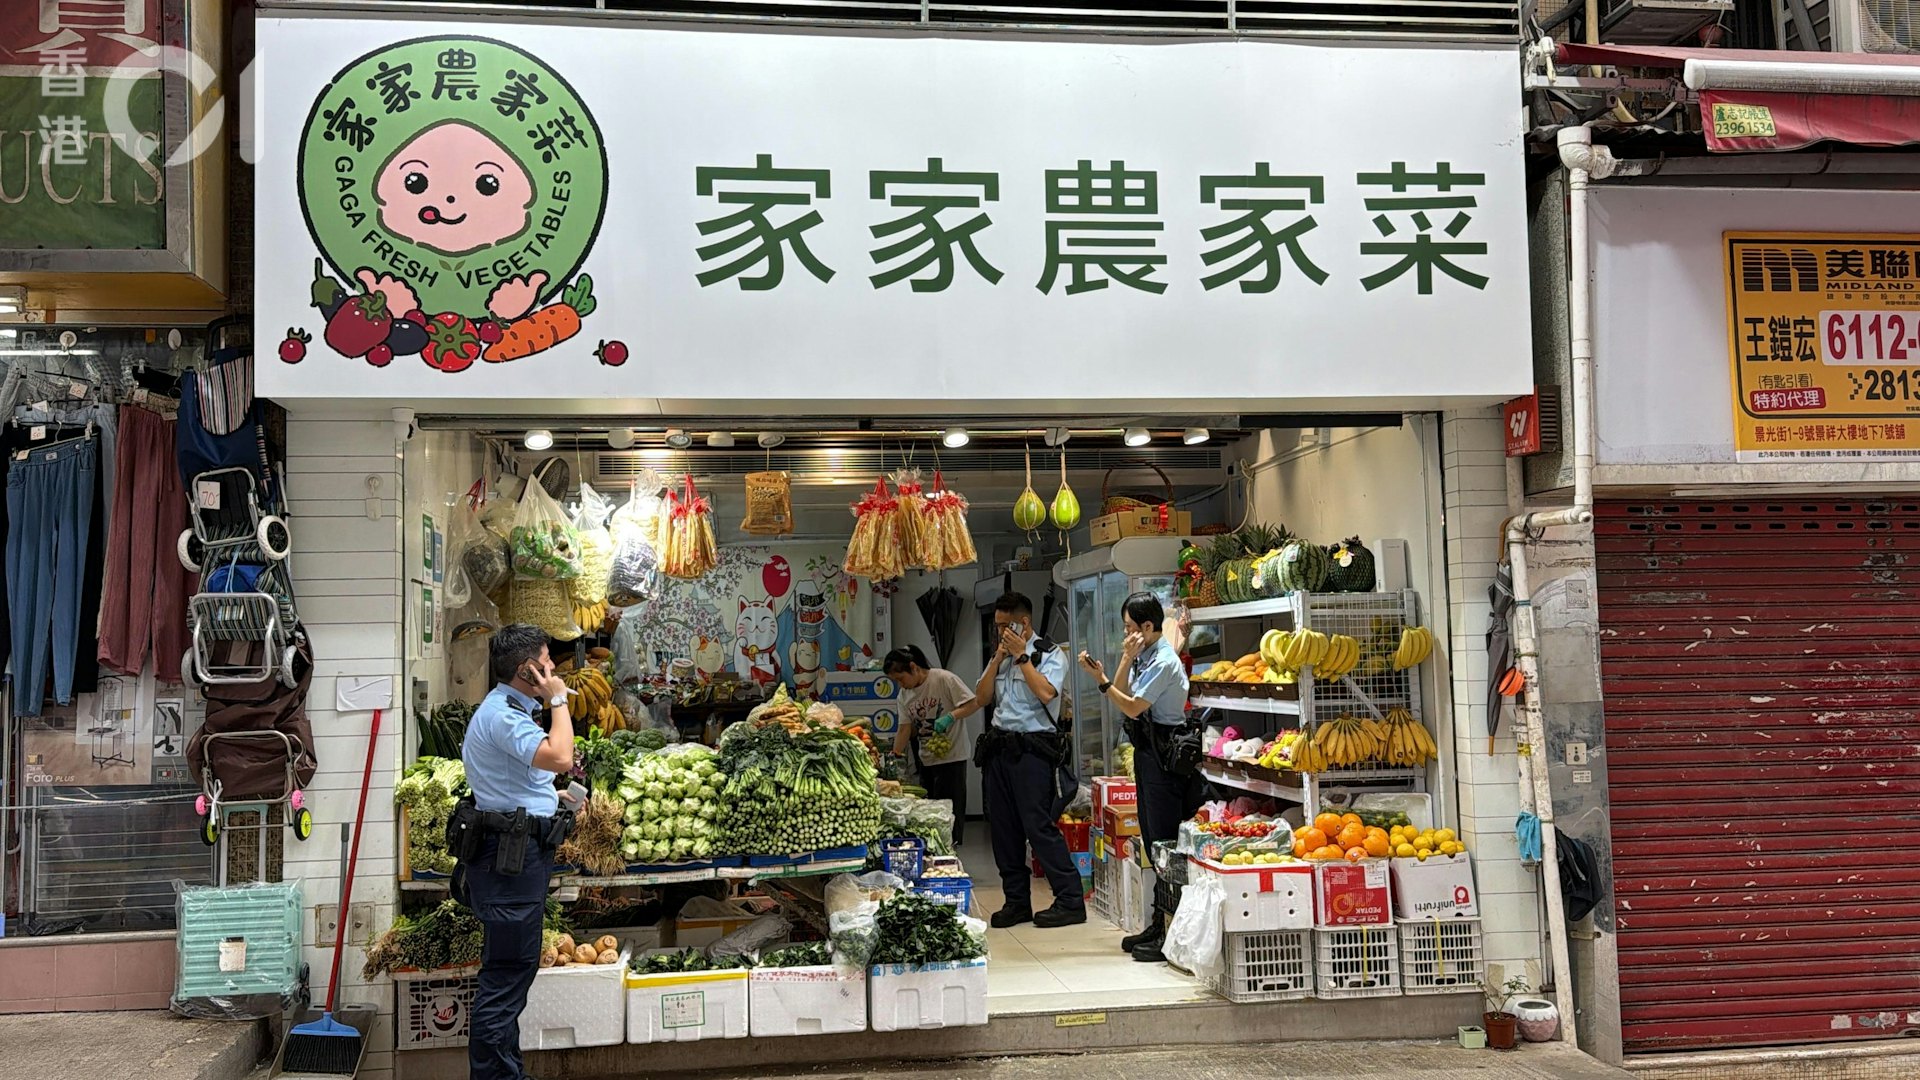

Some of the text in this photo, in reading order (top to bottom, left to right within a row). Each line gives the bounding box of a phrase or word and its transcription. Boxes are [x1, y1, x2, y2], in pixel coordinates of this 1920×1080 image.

[323, 48, 589, 164] 家家農家菜
[1716, 122, 1774, 135] 2396 1534
[335, 156, 572, 289] GAGA FRESH VEGETABLES
[695, 154, 1490, 295] 家家農家菜
[1825, 249, 1920, 279] 美聯
[1826, 282, 1915, 290] MIDLAND
[1744, 315, 1816, 361] 王鎧宏
[1827, 314, 1920, 359] 6112-
[1753, 390, 1821, 409] 特約代理
[26, 773, 75, 783] Faro PLUS
[1112, 792, 1137, 801] PEDT
[1355, 907, 1382, 916] PEDTAK
[1415, 900, 1456, 914] unifrutti
